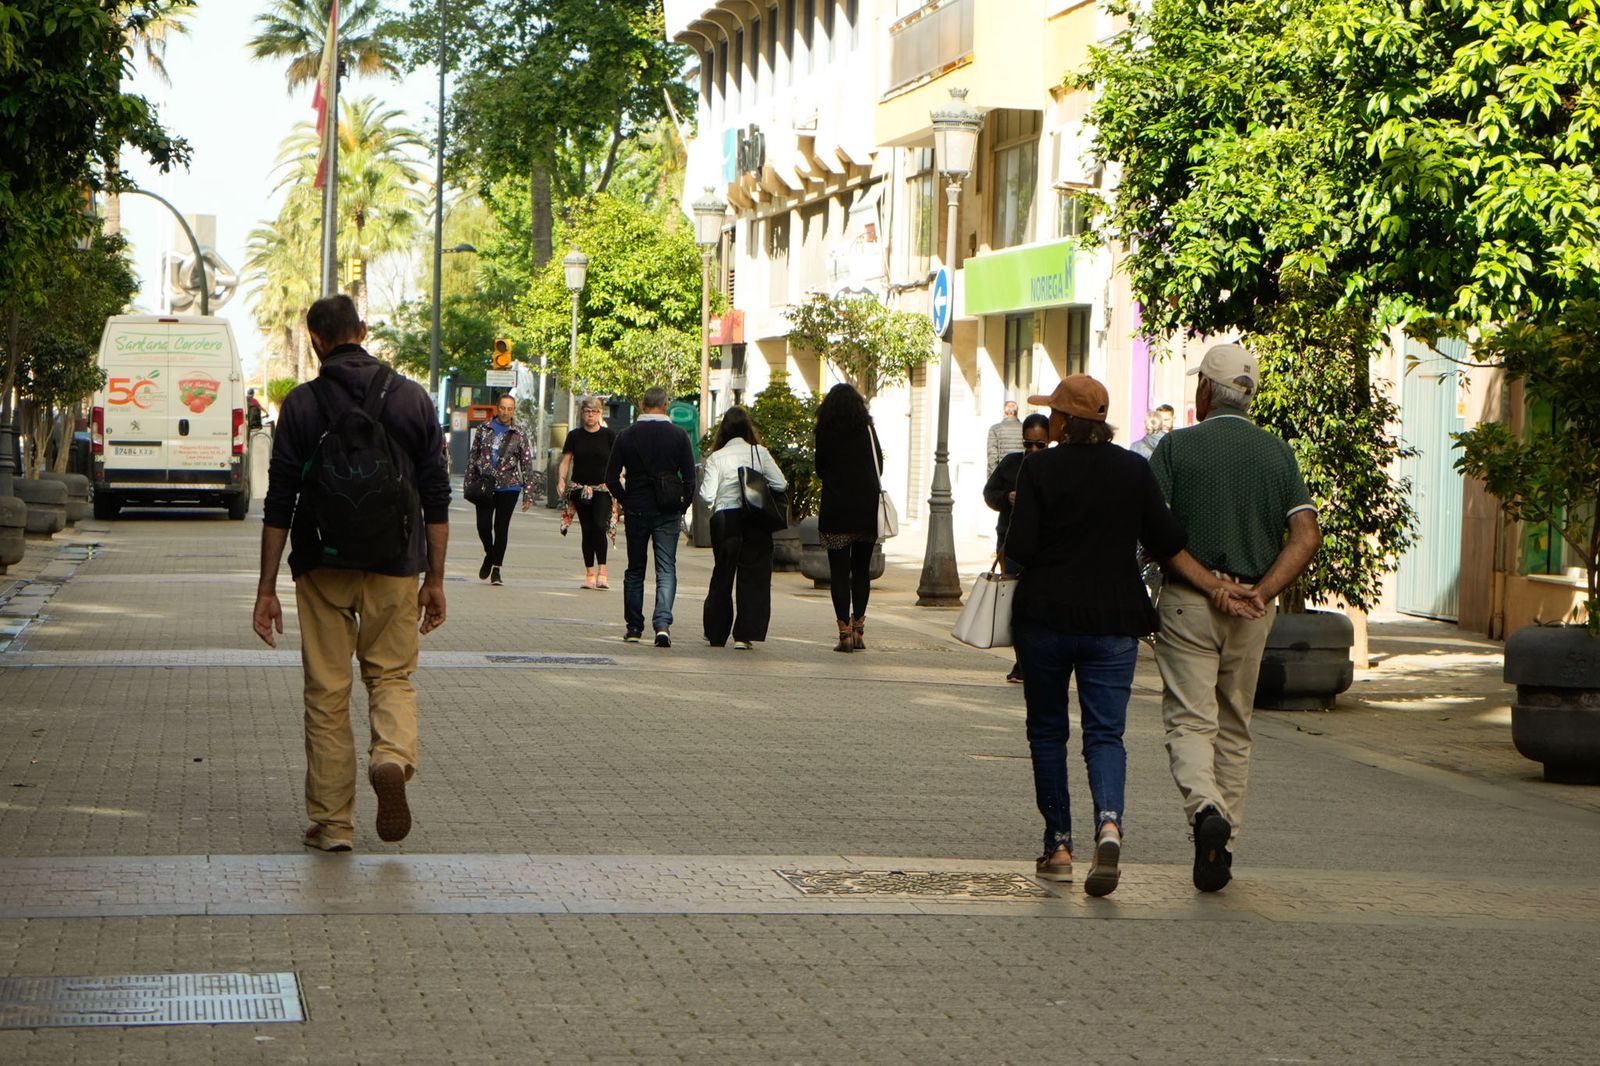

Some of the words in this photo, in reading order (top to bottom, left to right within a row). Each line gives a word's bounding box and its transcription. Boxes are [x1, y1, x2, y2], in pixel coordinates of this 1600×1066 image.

[1030, 273, 1063, 302] NORIEGA
[115, 335, 168, 351] Santana
[174, 336, 223, 351] Cordero
